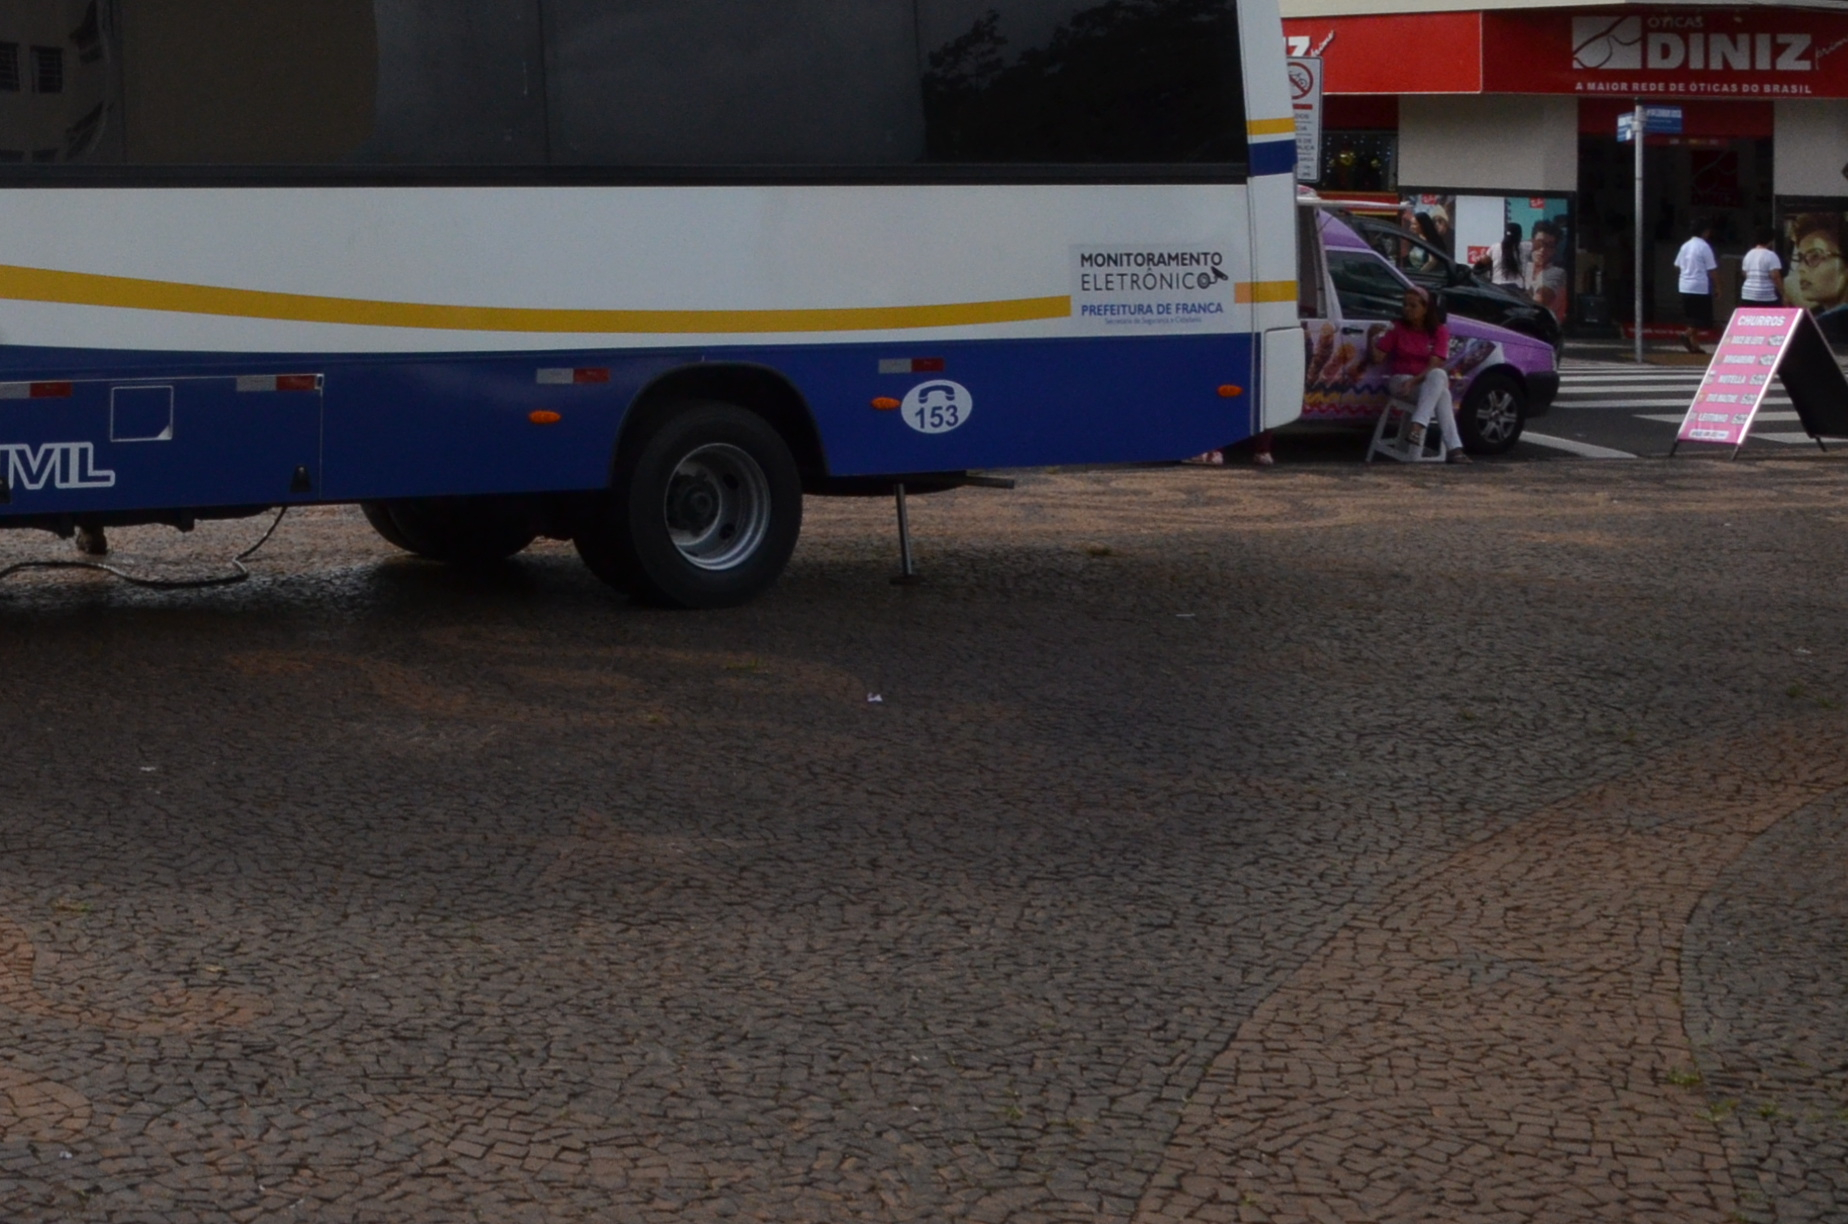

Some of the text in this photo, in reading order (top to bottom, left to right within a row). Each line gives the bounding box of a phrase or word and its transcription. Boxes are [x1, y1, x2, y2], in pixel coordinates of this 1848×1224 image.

[1647, 32, 1812, 71] DINIZ
[1575, 79, 1812, 94] A MAIOR REDE DE ÓTICAS DO BRASIL
[1080, 252, 1223, 267] MONITORAMENTO
[1081, 267, 1211, 291] ELETRÔNICO
[1081, 302, 1224, 316] PREFEITURA DE FRANCA
[1737, 315, 1786, 327] CHURROS
[915, 404, 959, 429] 153
